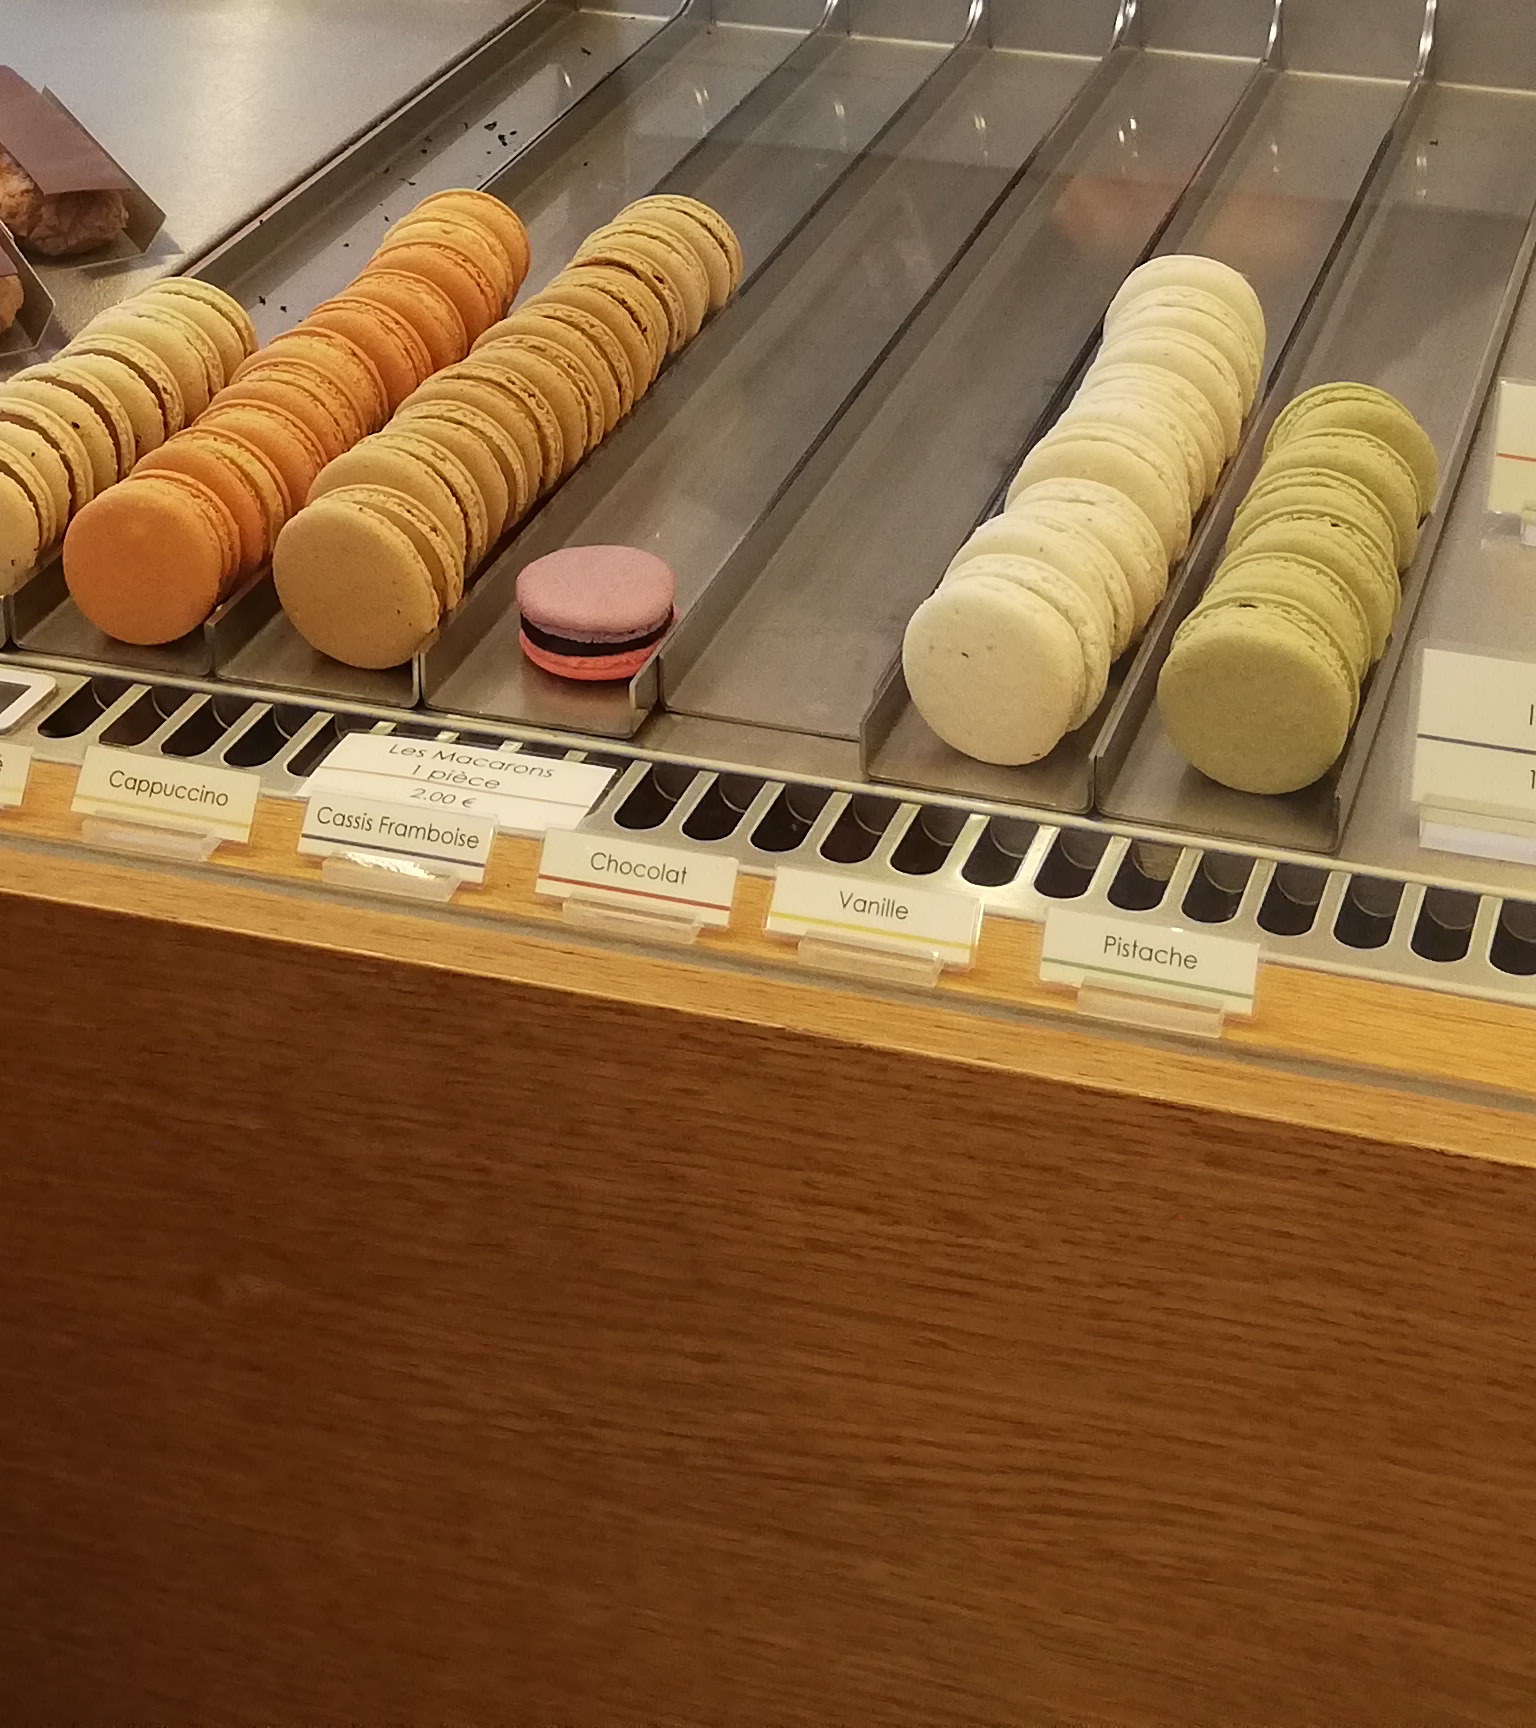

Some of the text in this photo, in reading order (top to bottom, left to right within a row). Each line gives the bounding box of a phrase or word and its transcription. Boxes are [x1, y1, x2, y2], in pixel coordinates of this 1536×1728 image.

[388, 742, 555, 779] Les Macarons
[108, 769, 230, 808] Cappuccino
[428, 767, 501, 791] pièce
[409, 787, 477, 808] 2.00 €
[316, 806, 480, 850] Cassis Framboise
[590, 851, 688, 887] Chocolat
[839, 889, 910, 922] Vanille
[1102, 933, 1199, 972] Pistache
